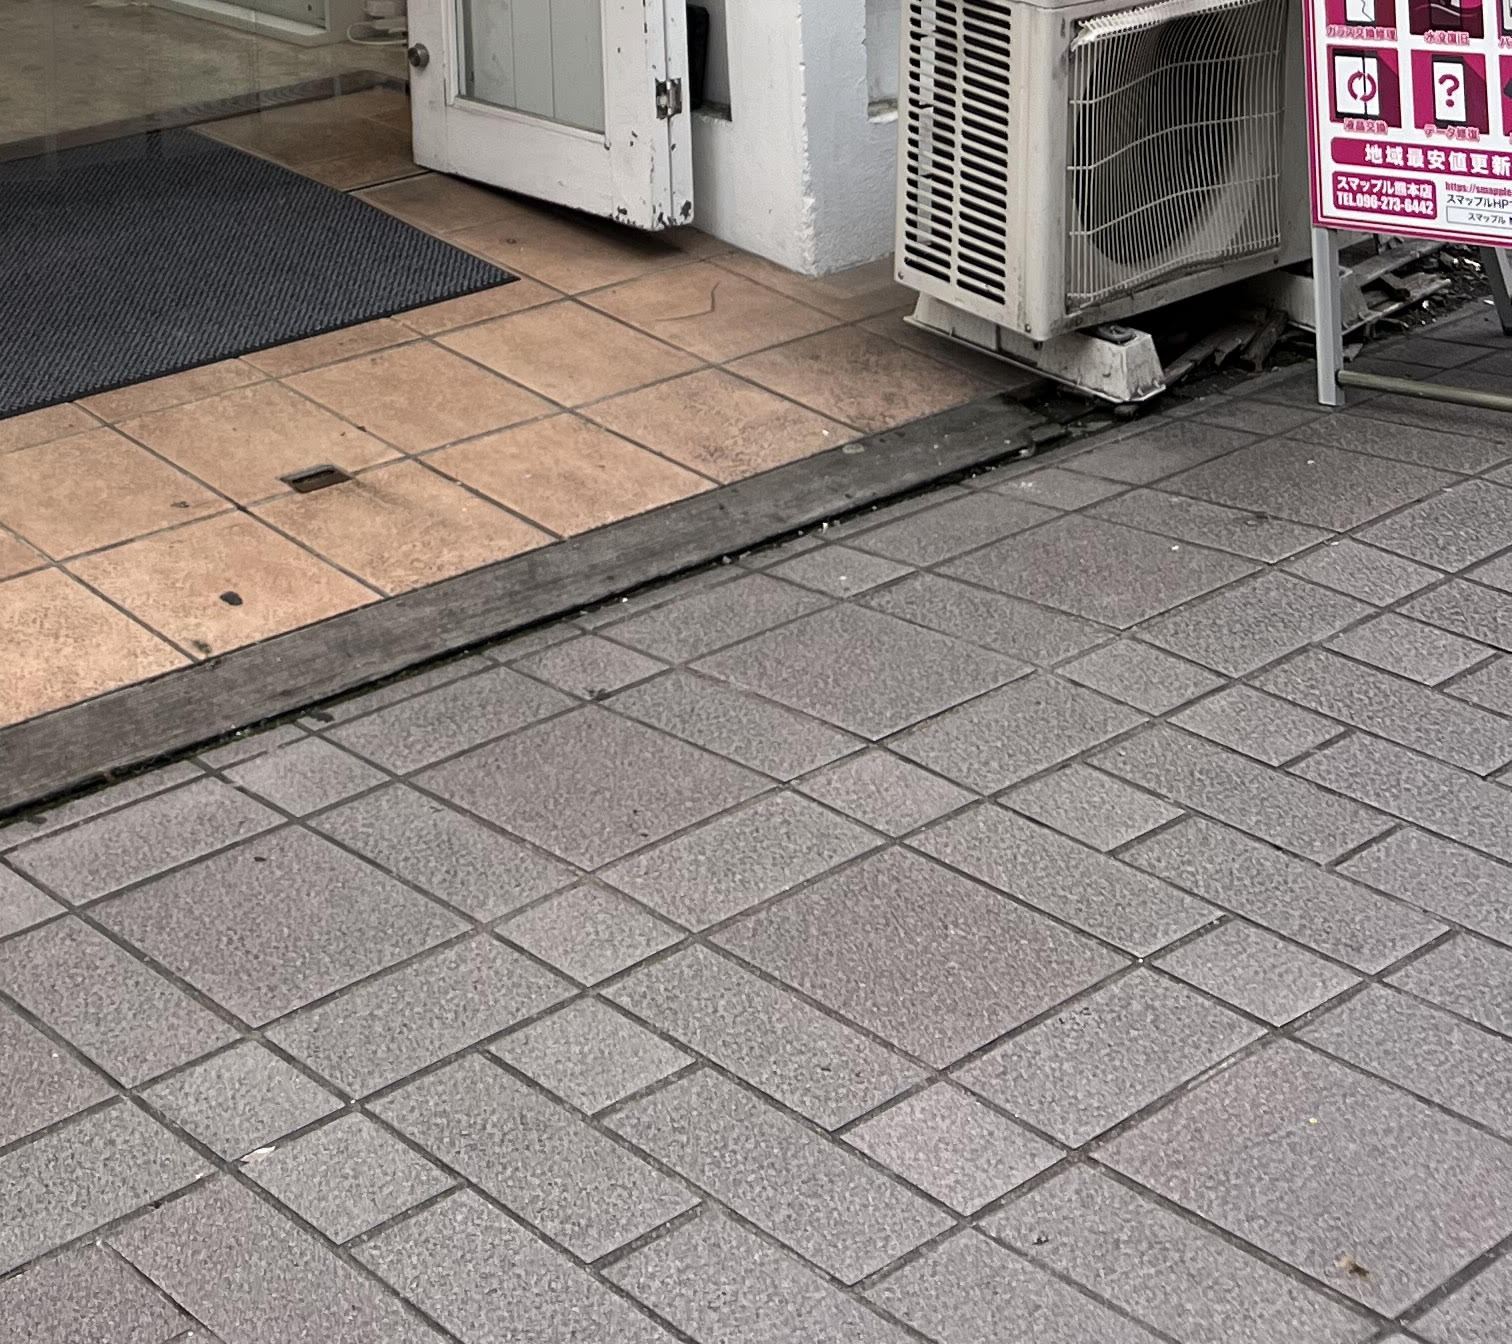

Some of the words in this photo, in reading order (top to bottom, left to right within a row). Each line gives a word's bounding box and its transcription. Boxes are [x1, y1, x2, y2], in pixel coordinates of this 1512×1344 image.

[1337, 175, 1433, 199] スマップル熊本店
